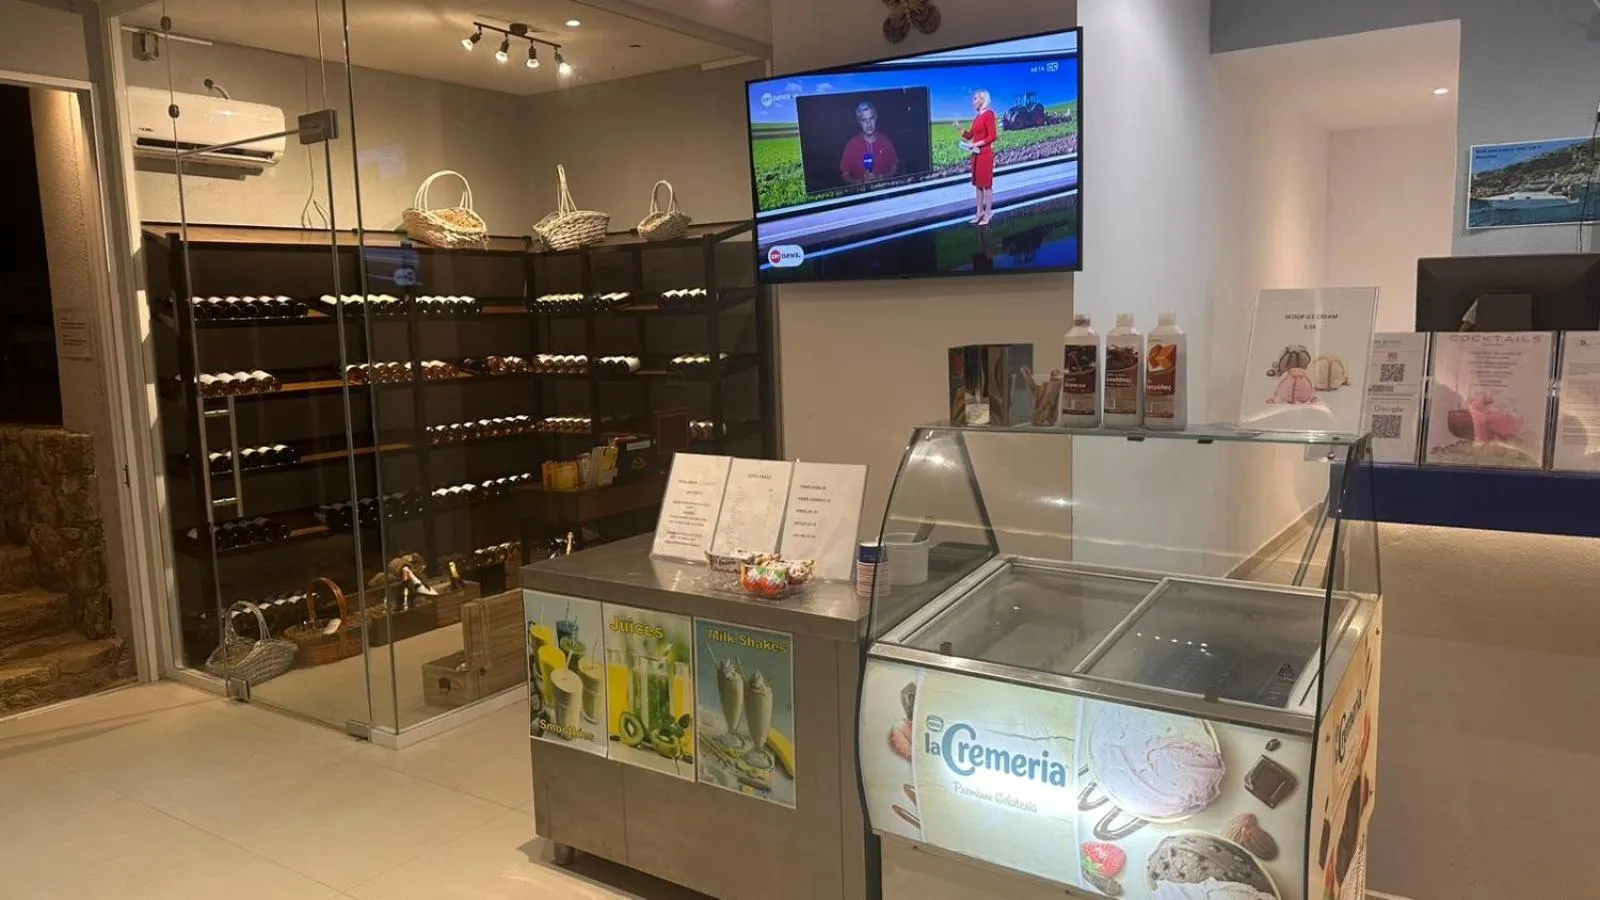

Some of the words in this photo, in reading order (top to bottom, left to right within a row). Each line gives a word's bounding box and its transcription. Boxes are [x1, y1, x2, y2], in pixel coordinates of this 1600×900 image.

[1449, 333, 1541, 343] COCKTAILS
[609, 615, 665, 641] Juices
[708, 628, 736, 645] Milk
[739, 634, 787, 656] Shakes
[540, 718, 595, 742] Smoothies
[924, 731, 941, 757] la
[941, 722, 1067, 788] Cremeria
